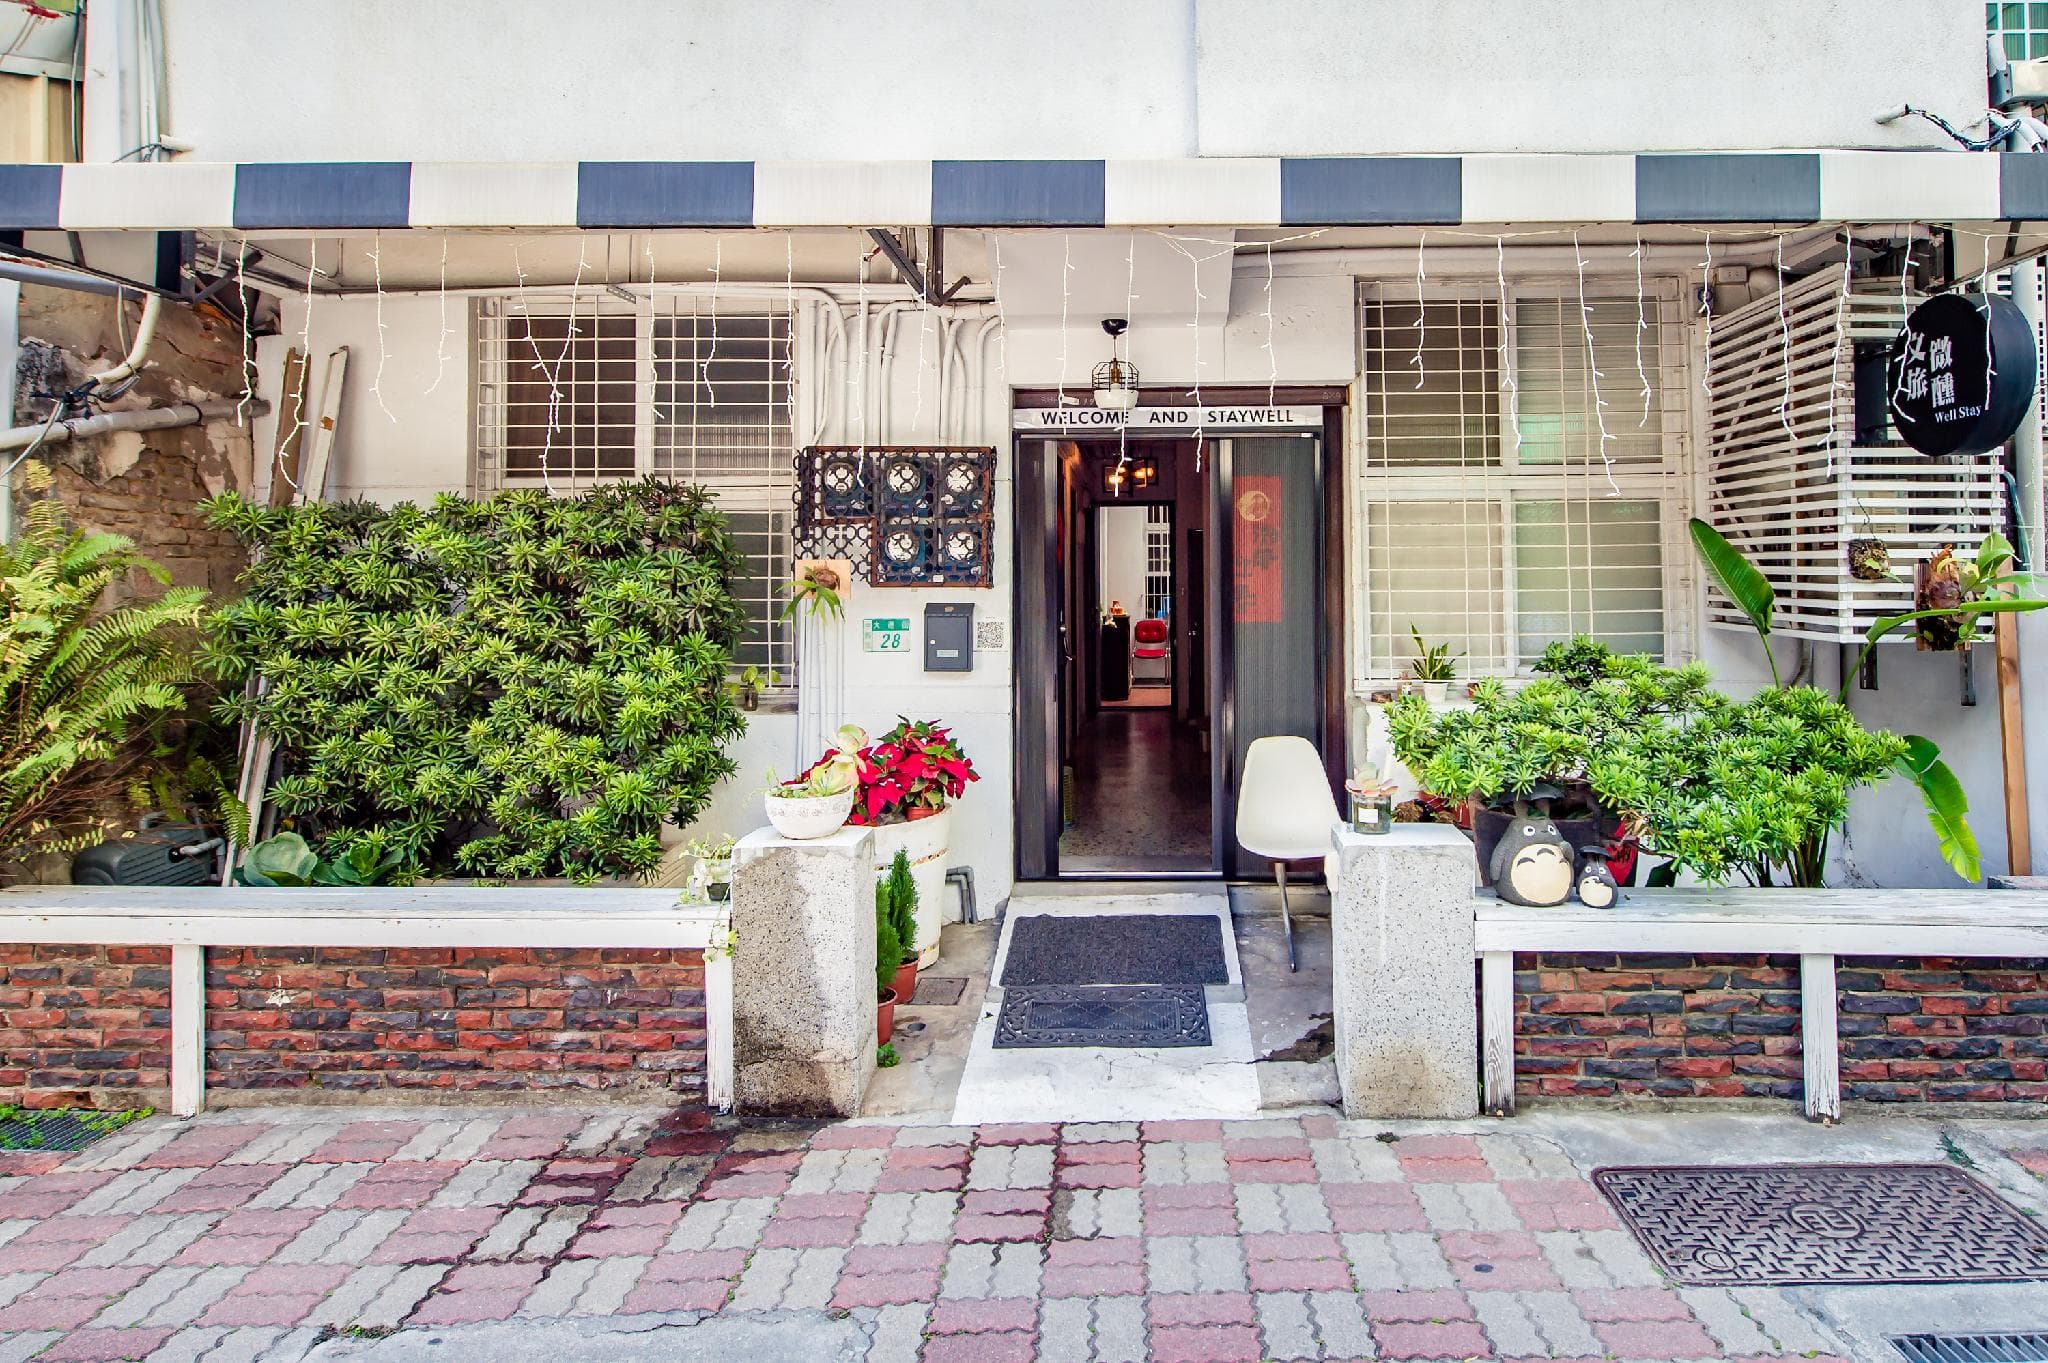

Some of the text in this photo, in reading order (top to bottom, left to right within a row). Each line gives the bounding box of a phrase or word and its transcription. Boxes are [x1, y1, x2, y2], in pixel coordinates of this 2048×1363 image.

[1041, 410, 1294, 425] WELCOME AND STAYWELL
[1935, 404, 1982, 423] Well Stay
[881, 633, 900, 648] 28
